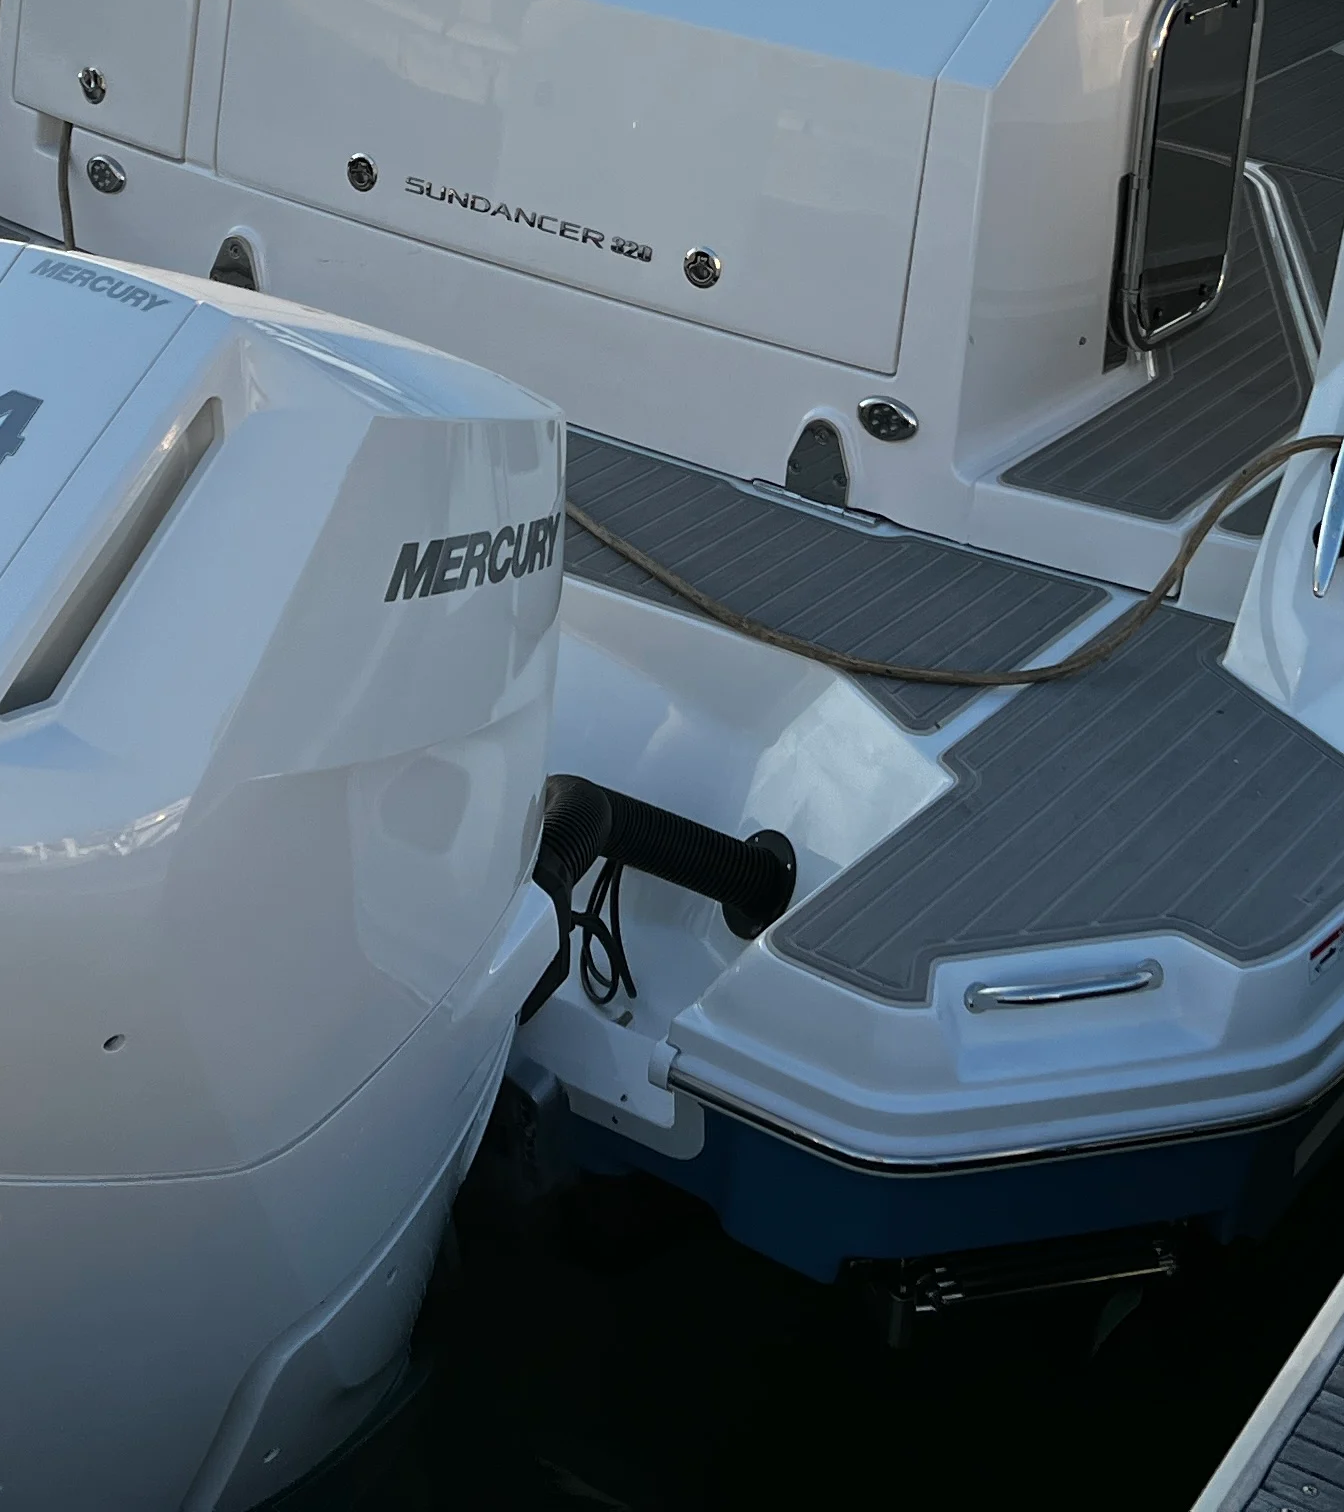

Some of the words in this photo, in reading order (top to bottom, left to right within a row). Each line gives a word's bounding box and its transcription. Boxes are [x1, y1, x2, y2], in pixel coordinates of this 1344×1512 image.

[405, 176, 606, 250] SUNDANCER
[610, 236, 653, 263] 320
[30, 258, 172, 312] MERCURY
[383, 511, 562, 603] MERCURY
